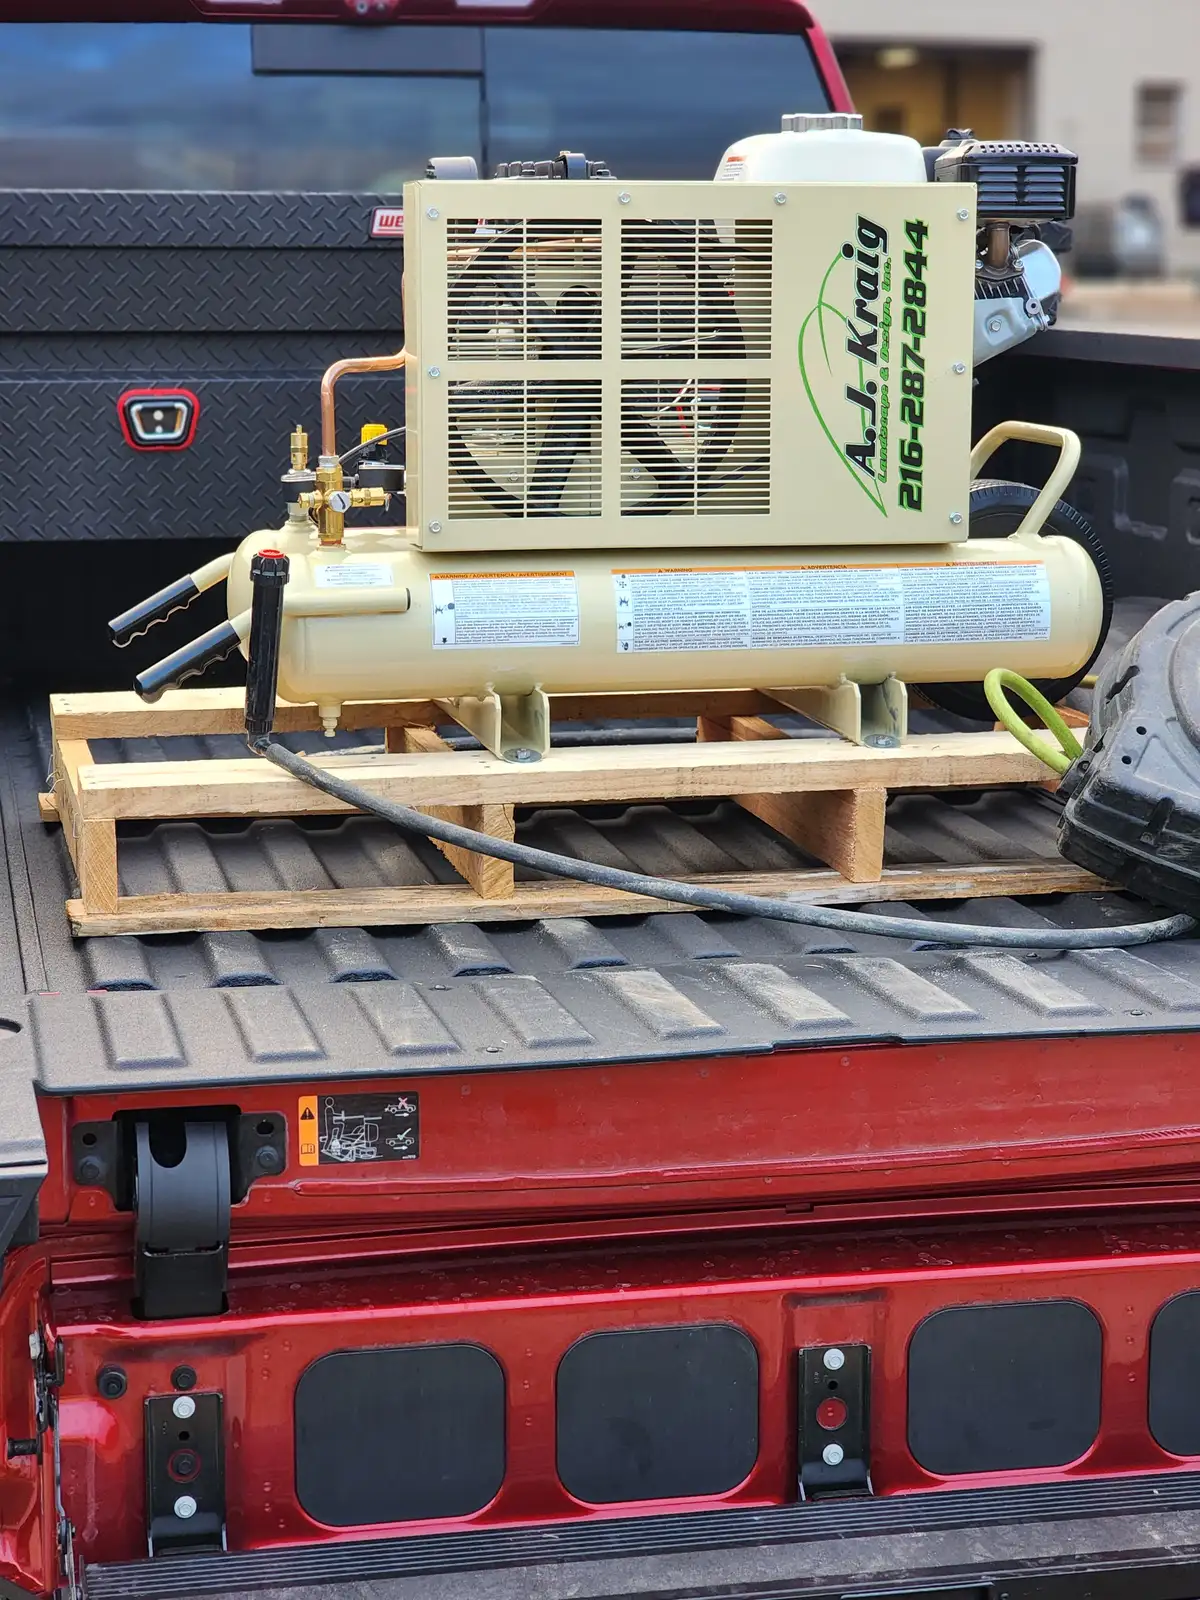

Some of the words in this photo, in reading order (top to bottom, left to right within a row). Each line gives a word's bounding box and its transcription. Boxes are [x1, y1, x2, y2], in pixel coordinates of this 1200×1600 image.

[840, 213, 889, 366] Kraig
[881, 257, 893, 292] Inc.
[881, 366, 890, 381] &
[898, 218, 929, 512] 216-287-2844
[844, 382, 879, 480] A.J.
[877, 381, 892, 483] Landscape
